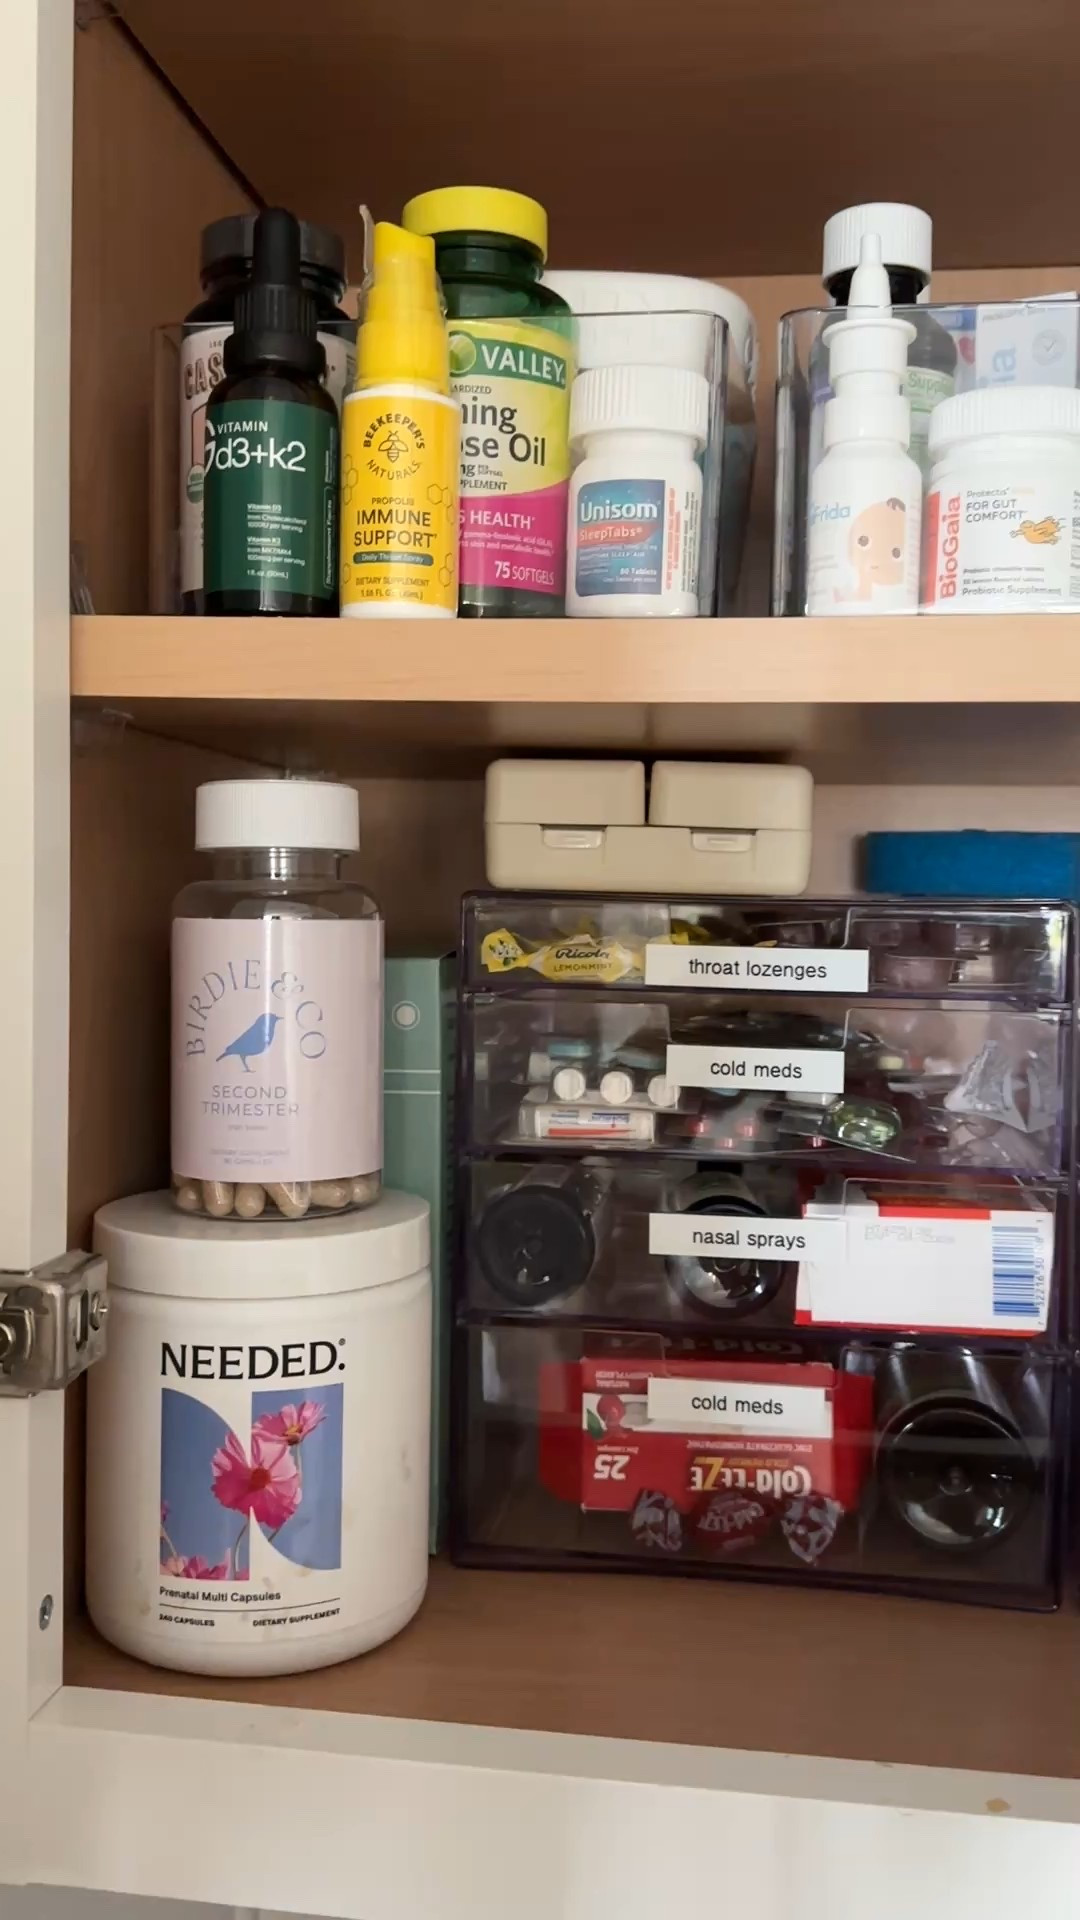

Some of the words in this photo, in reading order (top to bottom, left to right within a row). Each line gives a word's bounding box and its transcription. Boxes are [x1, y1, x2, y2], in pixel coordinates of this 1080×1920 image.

[481, 344, 564, 384] VALLEY
[217, 420, 269, 434] VITAMIN
[363, 413, 425, 449] BEEKEEPER'S
[215, 437, 306, 472] d3+k2
[509, 433, 546, 466] Oil
[366, 459, 422, 480] NATURALS
[581, 500, 658, 521] Unisom
[966, 501, 989, 512] FOR
[992, 499, 1017, 509] GUT
[357, 509, 431, 527] IMMUNE
[940, 495, 960, 599] BioGaia
[494, 560, 511, 579] 75
[512, 565, 554, 585] SOFTGELS
[555, 948, 609, 960] Ricola
[688, 958, 740, 976] throat
[746, 961, 827, 981] lozenges
[185, 958, 261, 1057] BIRDIE
[296, 1000, 327, 1060] CO
[710, 1061, 746, 1077] cold
[754, 1063, 803, 1079] meds
[212, 1084, 287, 1099] SECOND
[200, 1101, 300, 1117] TRIMESTER
[692, 1230, 740, 1245] nasal
[747, 1232, 806, 1251] sprays
[691, 1395, 727, 1411] cold
[735, 1398, 784, 1415] meds
[593, 1455, 631, 1480] 25
[159, 1586, 199, 1600] Prenatal
[201, 1592, 228, 1602] Multi
[230, 1592, 281, 1603] Capsules
[174, 1616, 215, 1627] CAPSULES
[252, 1617, 288, 1627] DIETARY
[289, 1608, 340, 1624] SUPPLEMENT
